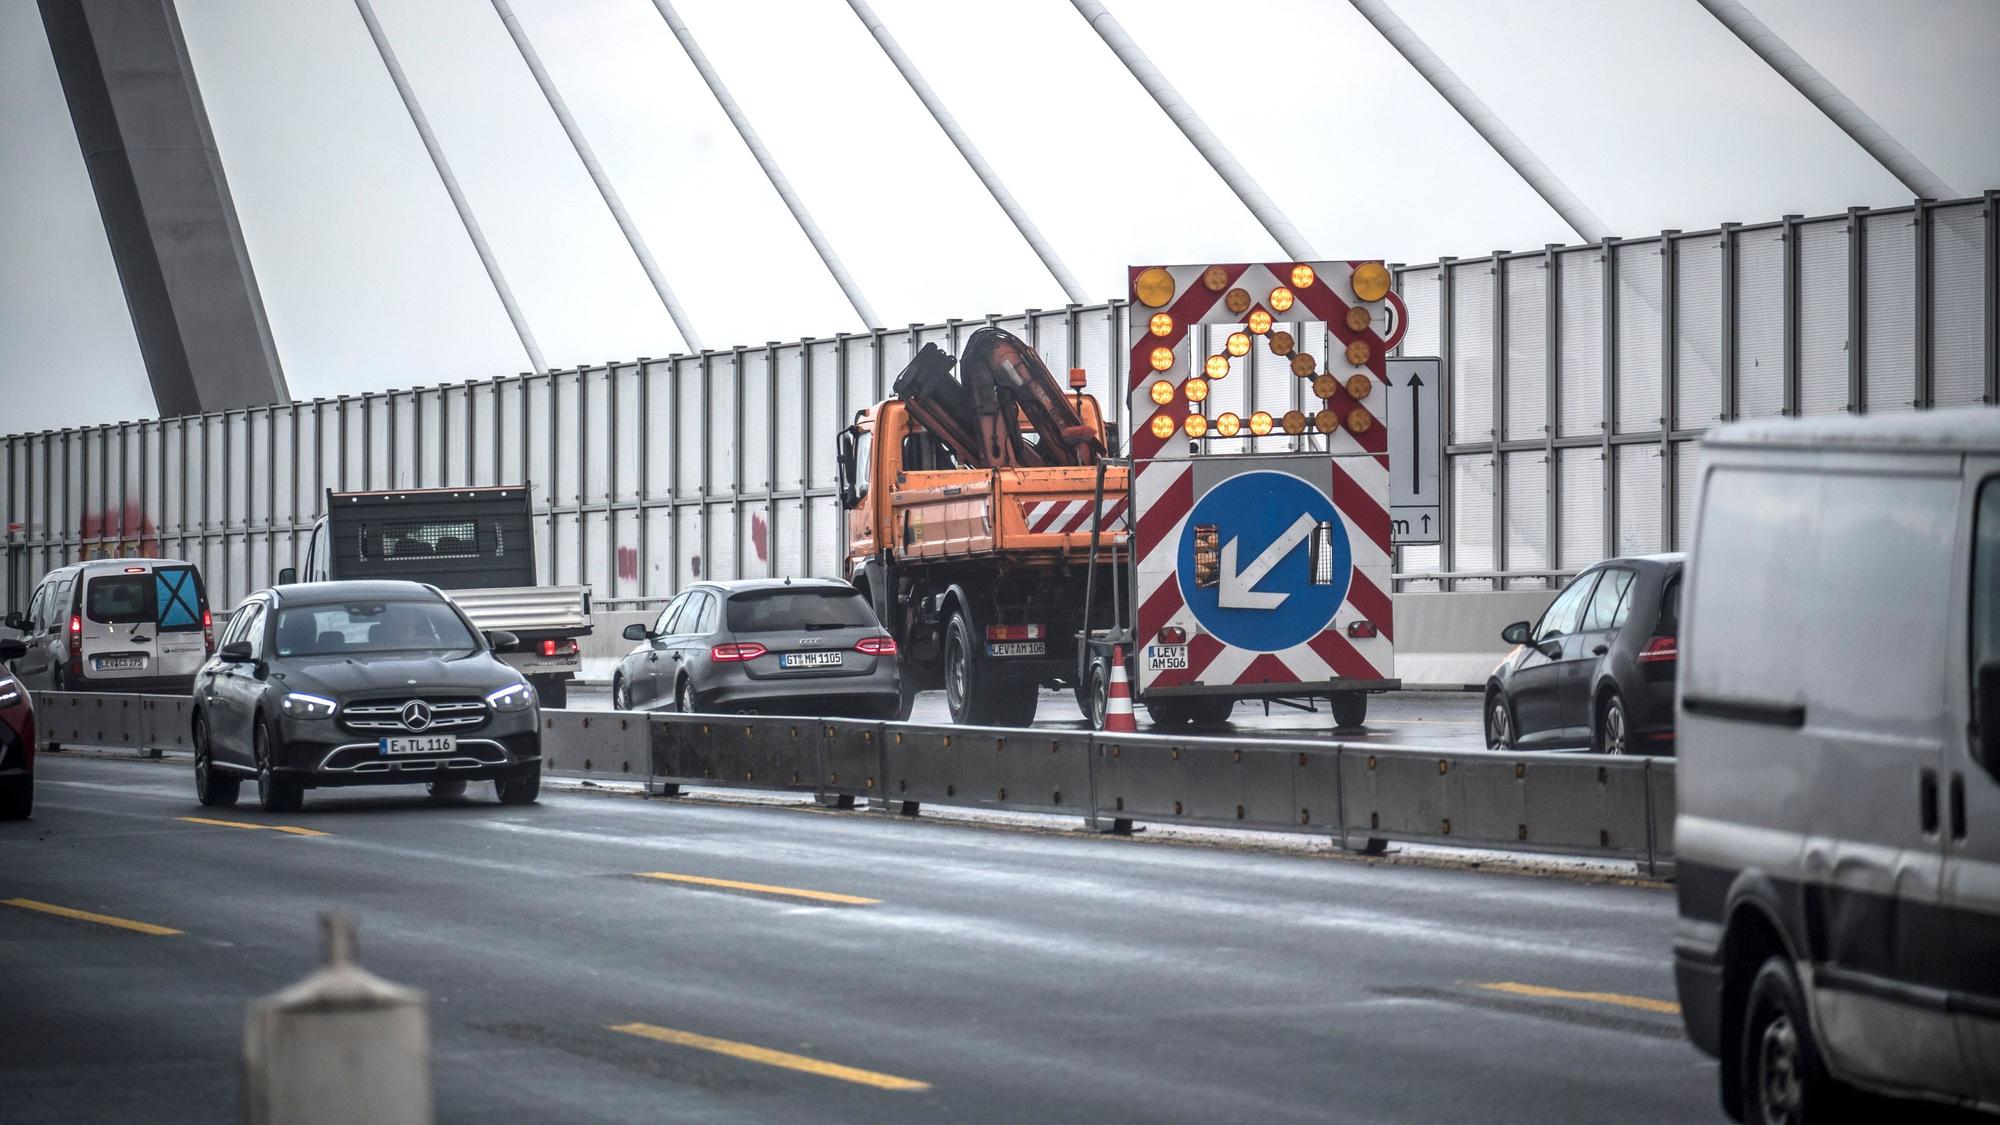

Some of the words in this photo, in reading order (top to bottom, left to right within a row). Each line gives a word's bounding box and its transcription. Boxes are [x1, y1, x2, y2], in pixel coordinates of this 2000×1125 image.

[993, 644, 1010, 655] LEV
[1157, 647, 1177, 658] LEV
[787, 655, 798, 665] GT
[804, 654, 817, 664] MH
[818, 653, 841, 664] 1105
[1152, 658, 1166, 669] AM
[1167, 657, 1186, 668] 506
[391, 740, 400, 752] E
[408, 739, 424, 752] TL
[427, 738, 450, 751] 116
